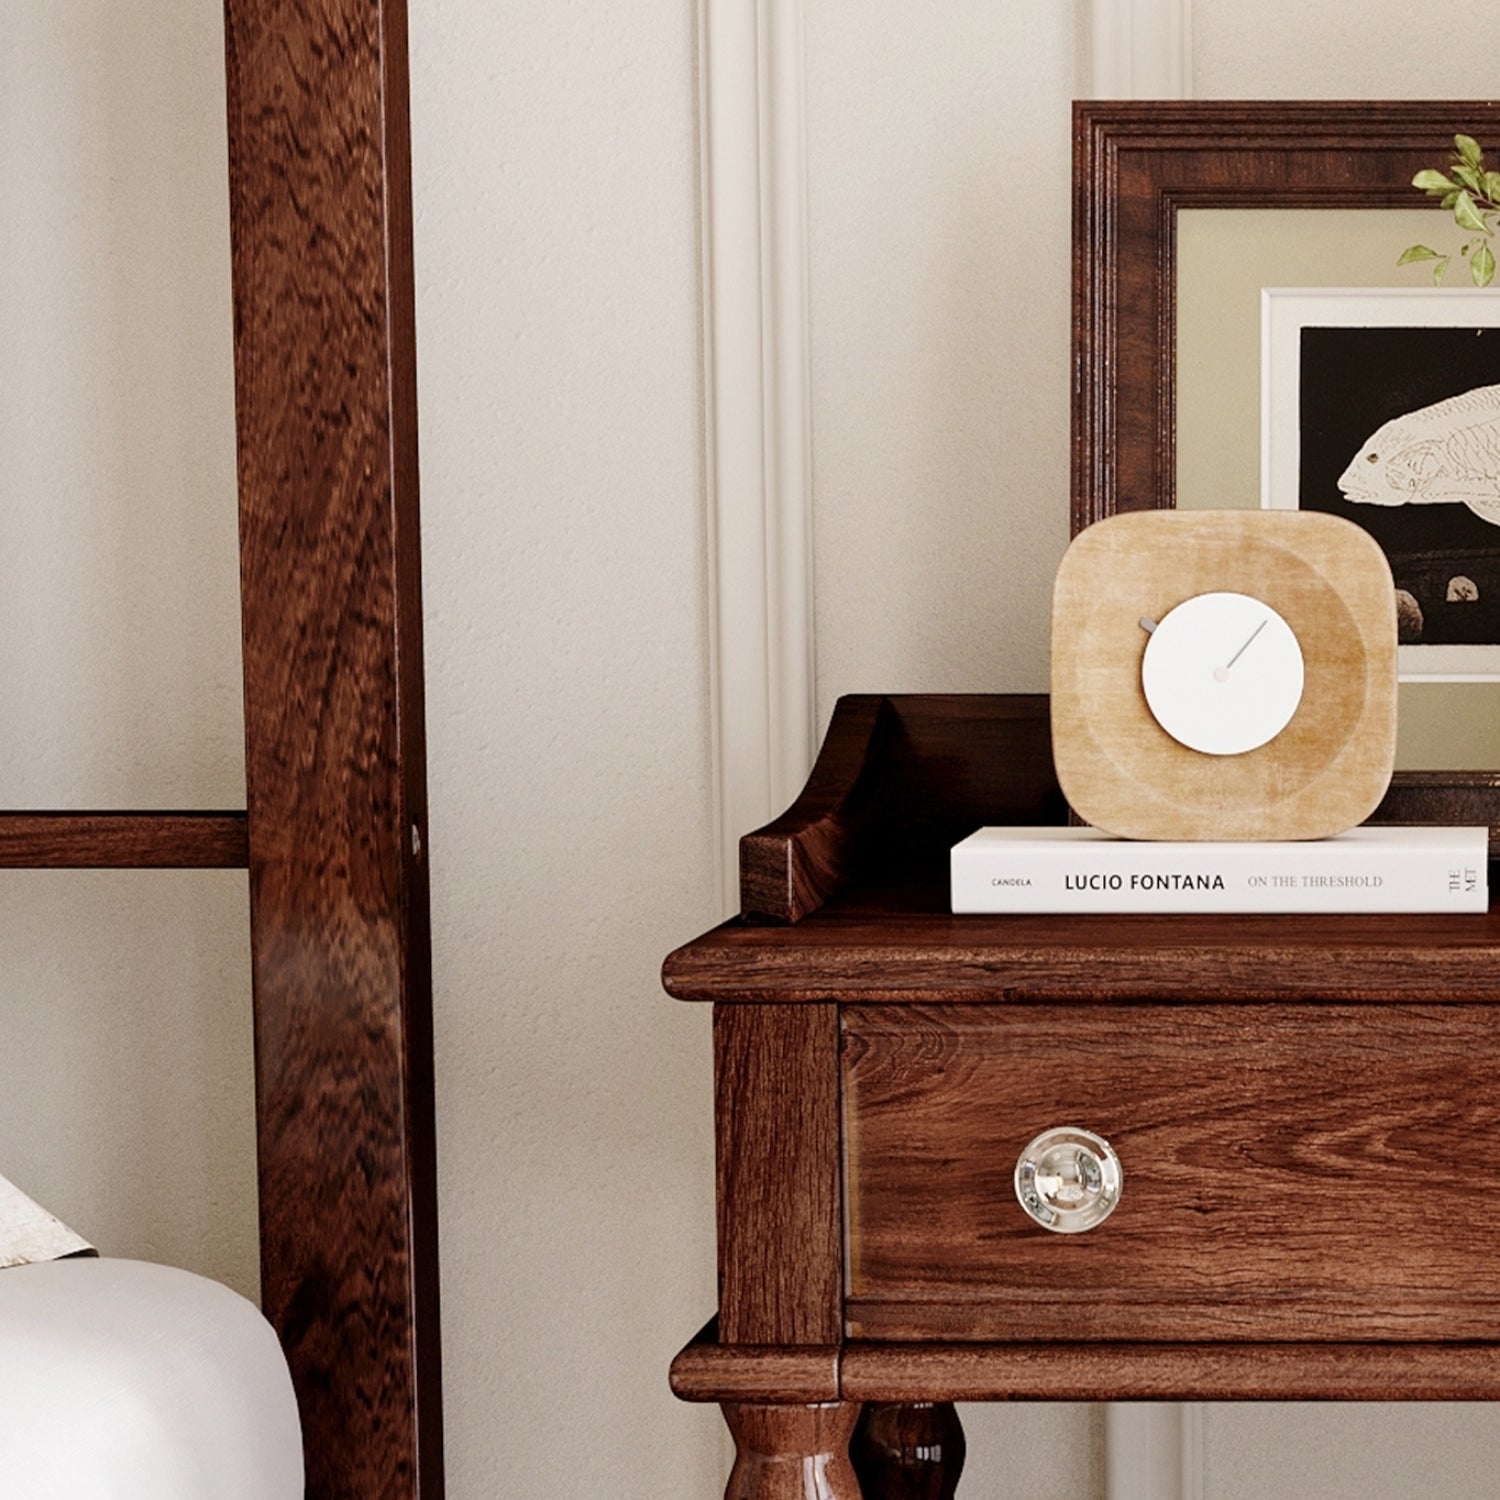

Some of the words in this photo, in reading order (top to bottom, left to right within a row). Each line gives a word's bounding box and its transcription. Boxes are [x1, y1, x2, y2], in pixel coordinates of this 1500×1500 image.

[991, 878, 1032, 886] CANDELA
[1065, 874, 1123, 890] LUCIO
[1130, 874, 1226, 890] FONTANA
[1247, 875, 1268, 888] ON
[1271, 875, 1298, 888] THE
[1302, 875, 1383, 888] THRESHOLD
[1449, 869, 1460, 893] THE
[1464, 867, 1477, 893] MET
